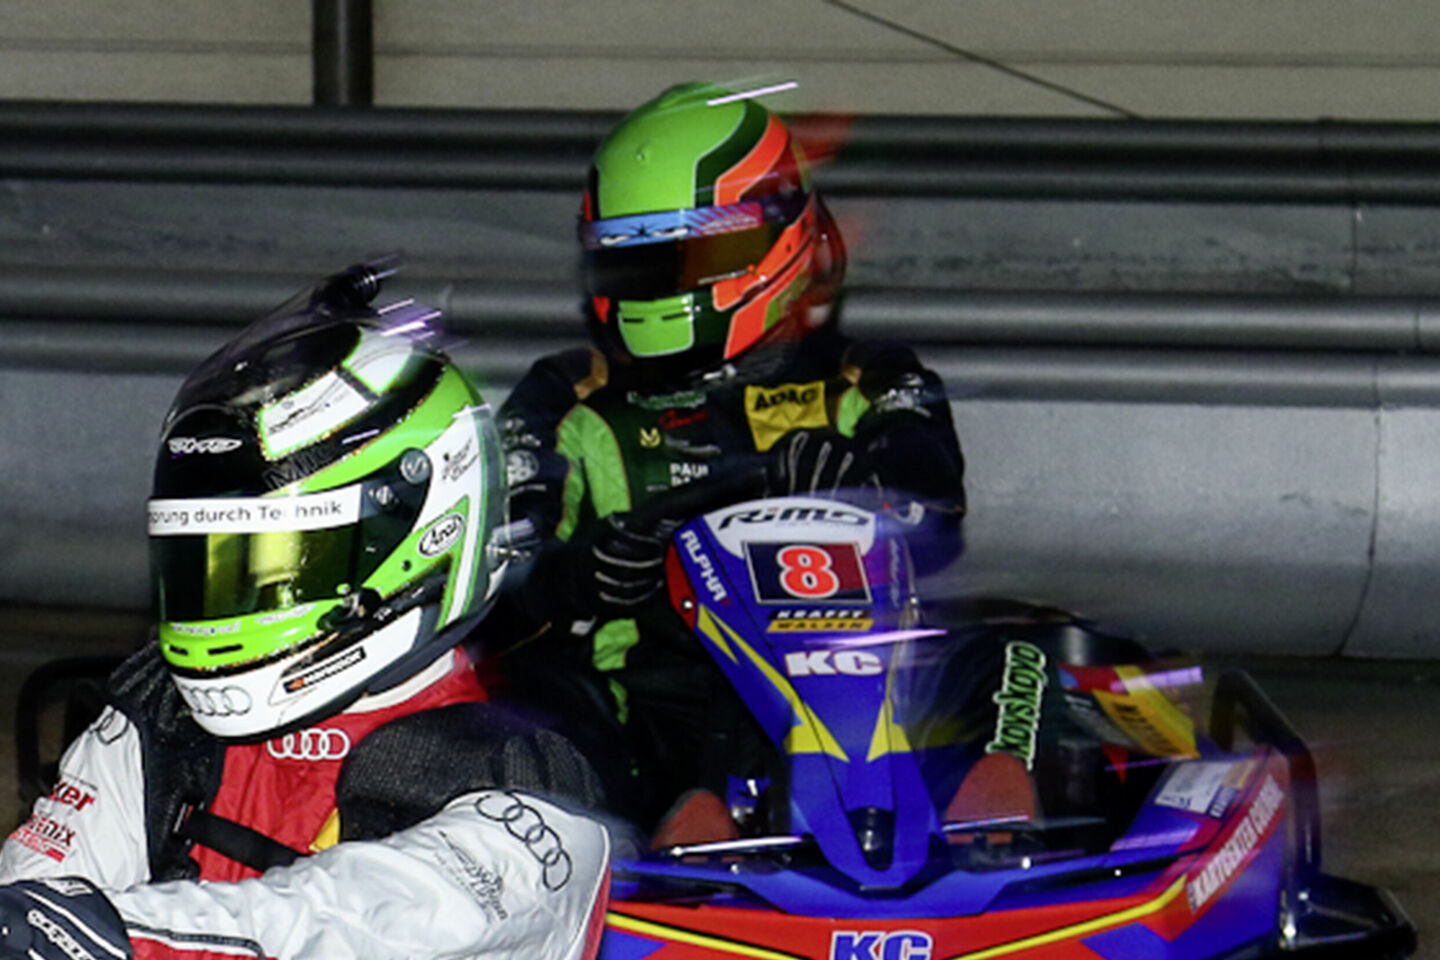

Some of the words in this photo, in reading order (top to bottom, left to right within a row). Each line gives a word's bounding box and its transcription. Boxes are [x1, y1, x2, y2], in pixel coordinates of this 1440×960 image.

[194, 508, 250, 521] durch
[258, 500, 342, 519] Tehnik
[681, 529, 728, 602] ALPHA
[776, 544, 839, 599] 8
[784, 650, 883, 676] KC
